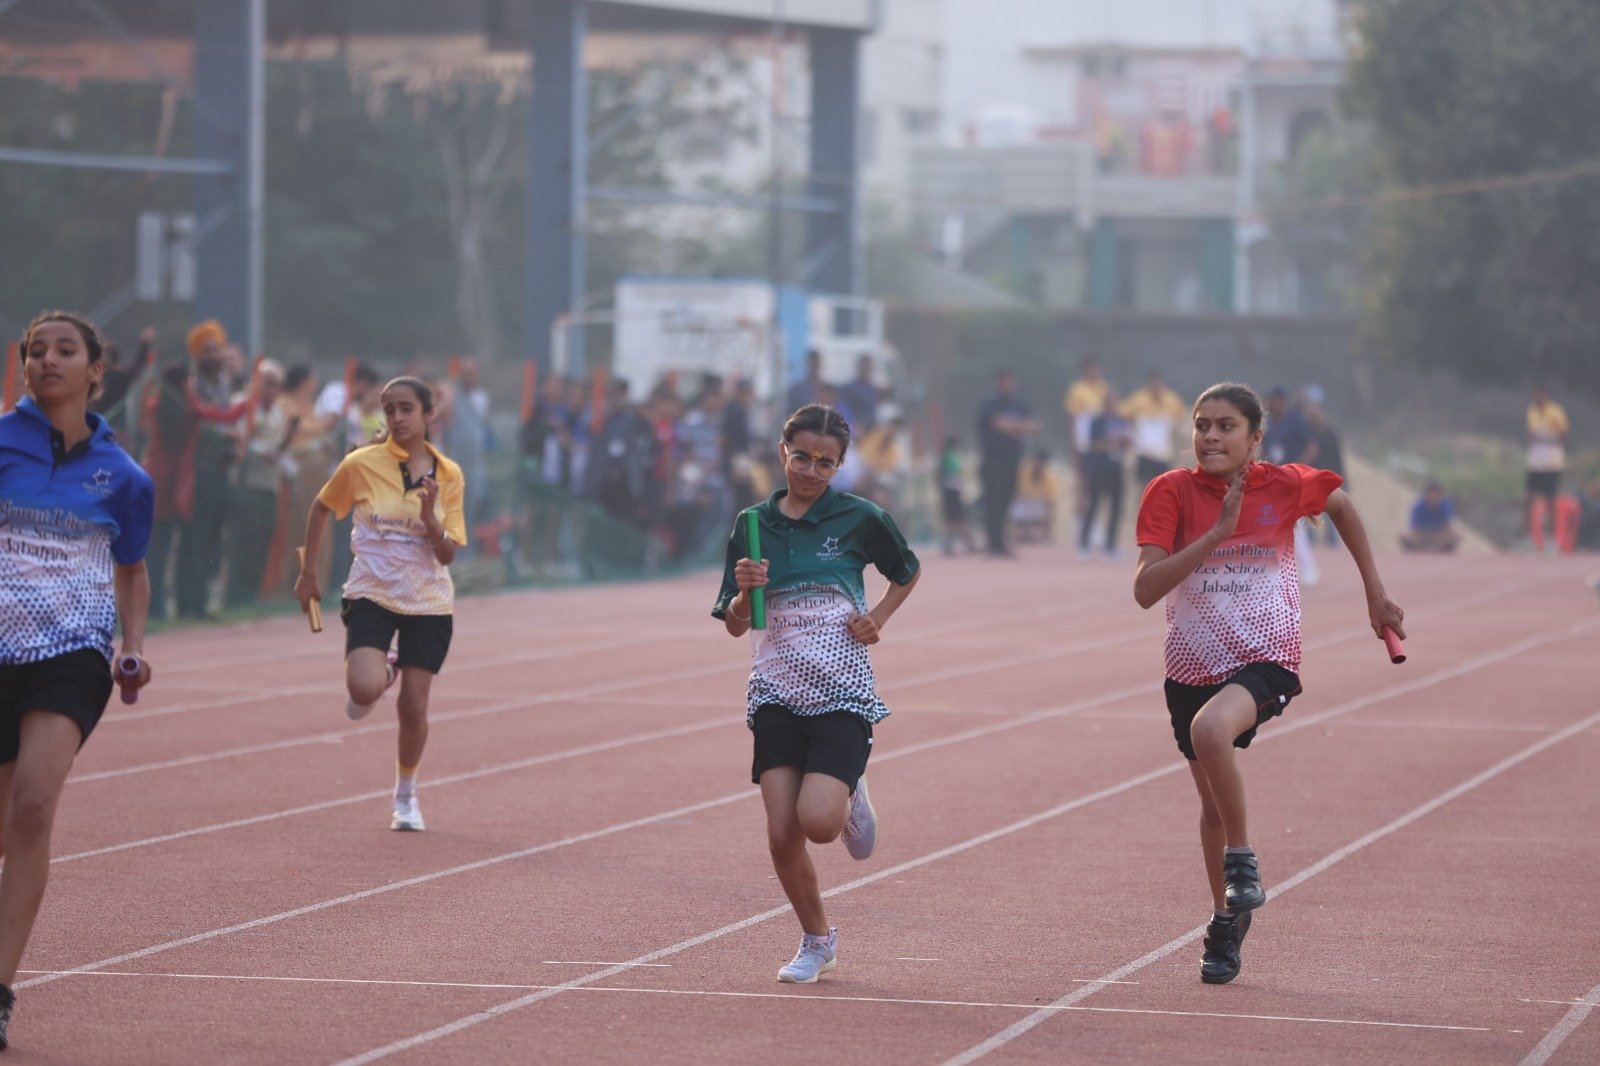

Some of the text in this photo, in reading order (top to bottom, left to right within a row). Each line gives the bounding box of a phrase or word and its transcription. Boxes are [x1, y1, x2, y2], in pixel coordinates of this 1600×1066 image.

[1240, 542, 1277, 556] Litera
[1194, 560, 1267, 575] Zee School
[1201, 580, 1254, 596] Jabalpur
[788, 591, 836, 610] School
